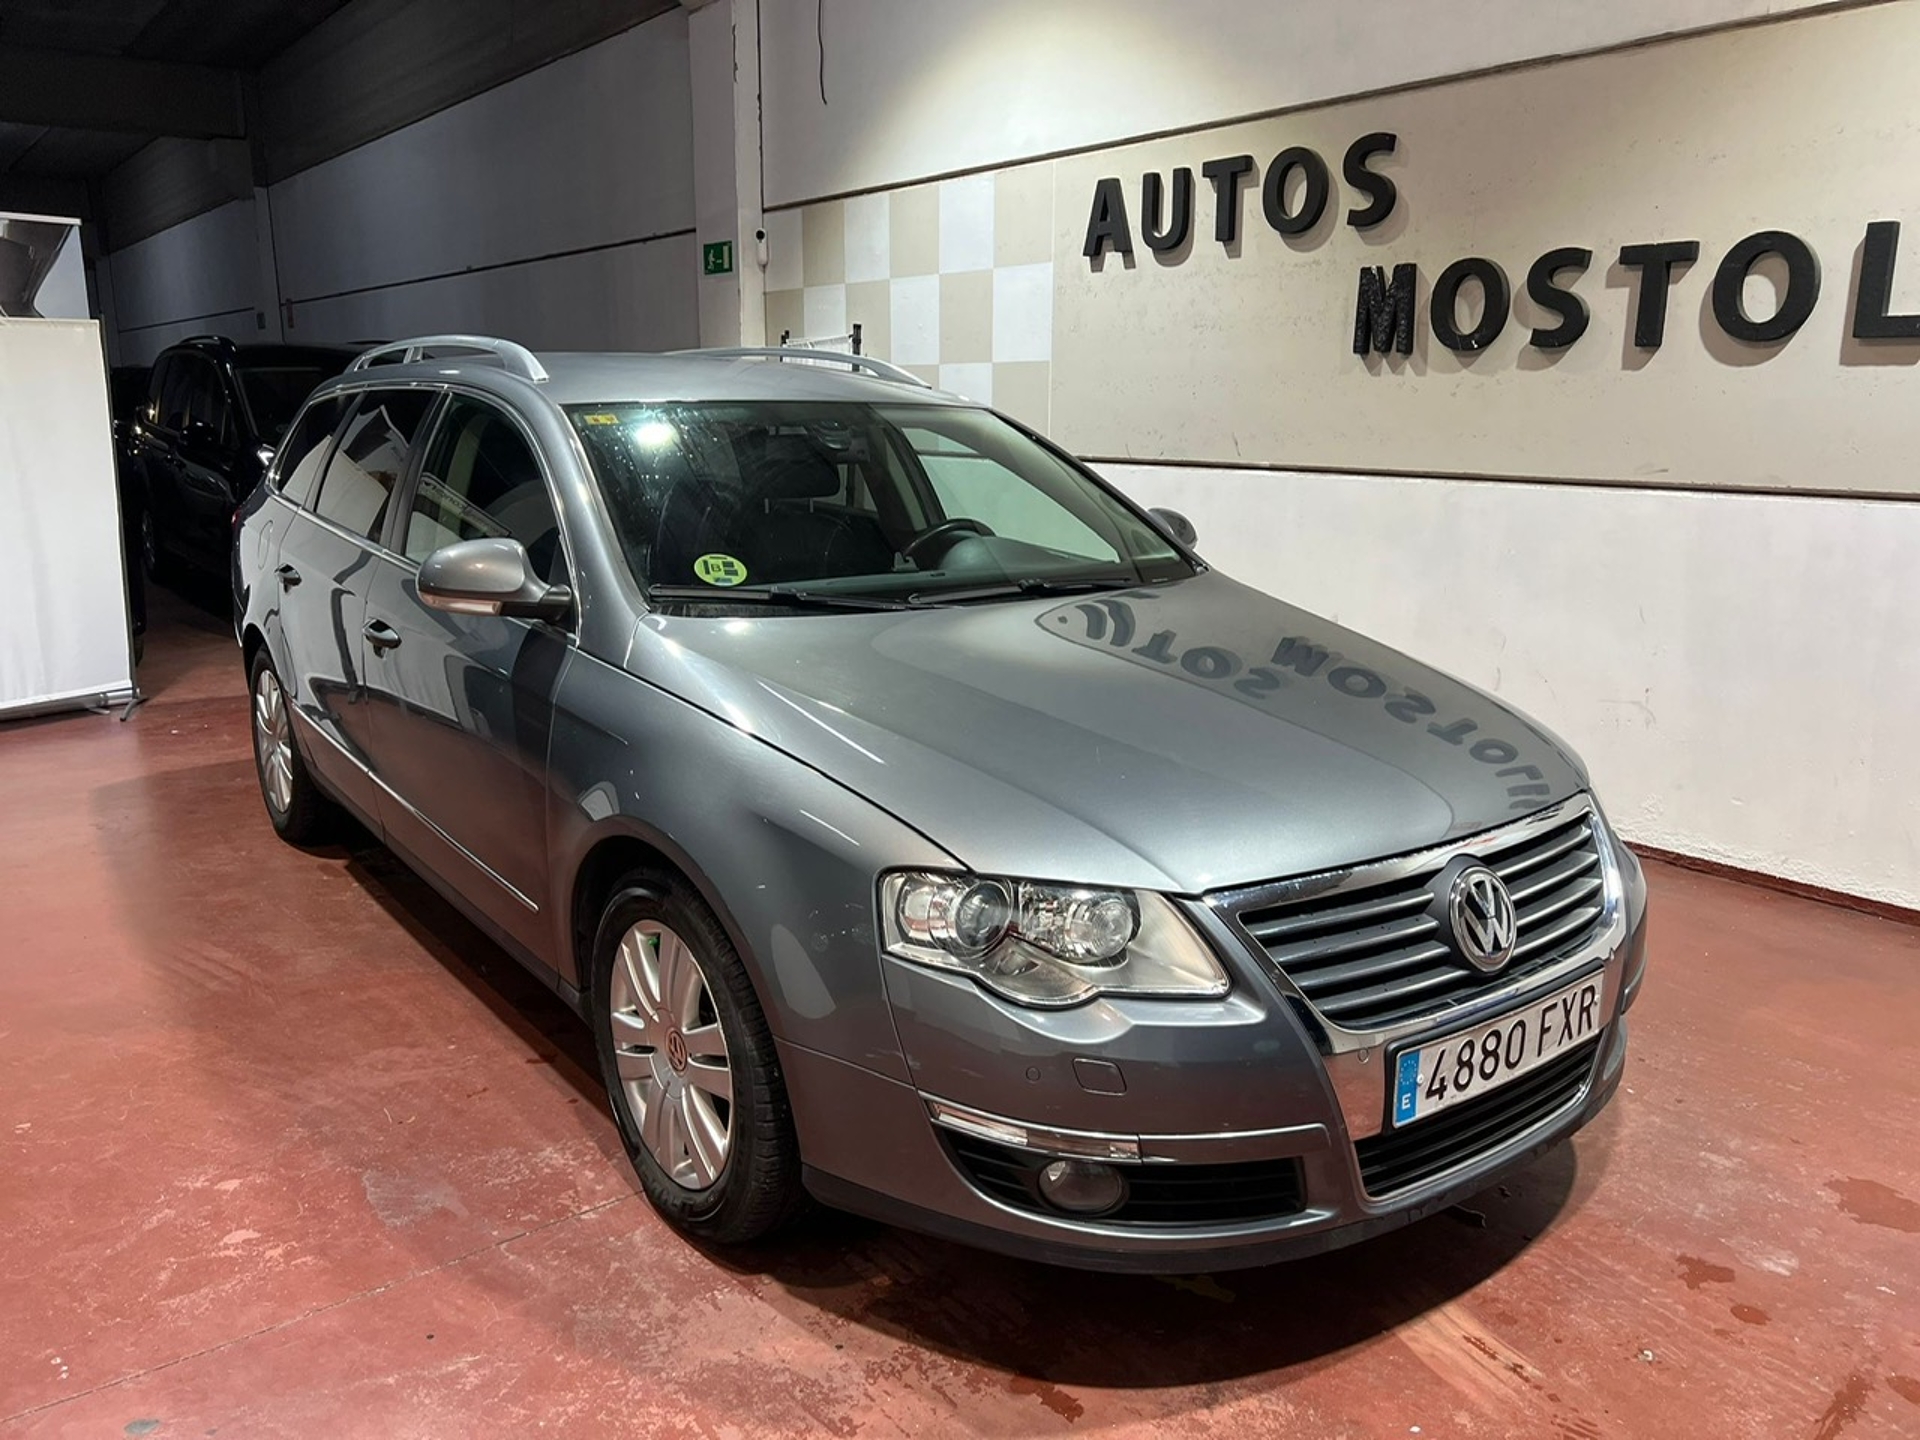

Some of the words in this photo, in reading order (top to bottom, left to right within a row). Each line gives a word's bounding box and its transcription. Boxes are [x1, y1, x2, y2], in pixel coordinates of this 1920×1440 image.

[1083, 132, 1397, 257] AUTOS
[1352, 221, 1920, 355] MOSTOL
[1401, 1093, 1412, 1110] E
[1425, 1019, 1526, 1101] 4880
[1536, 984, 1597, 1058] FXR
